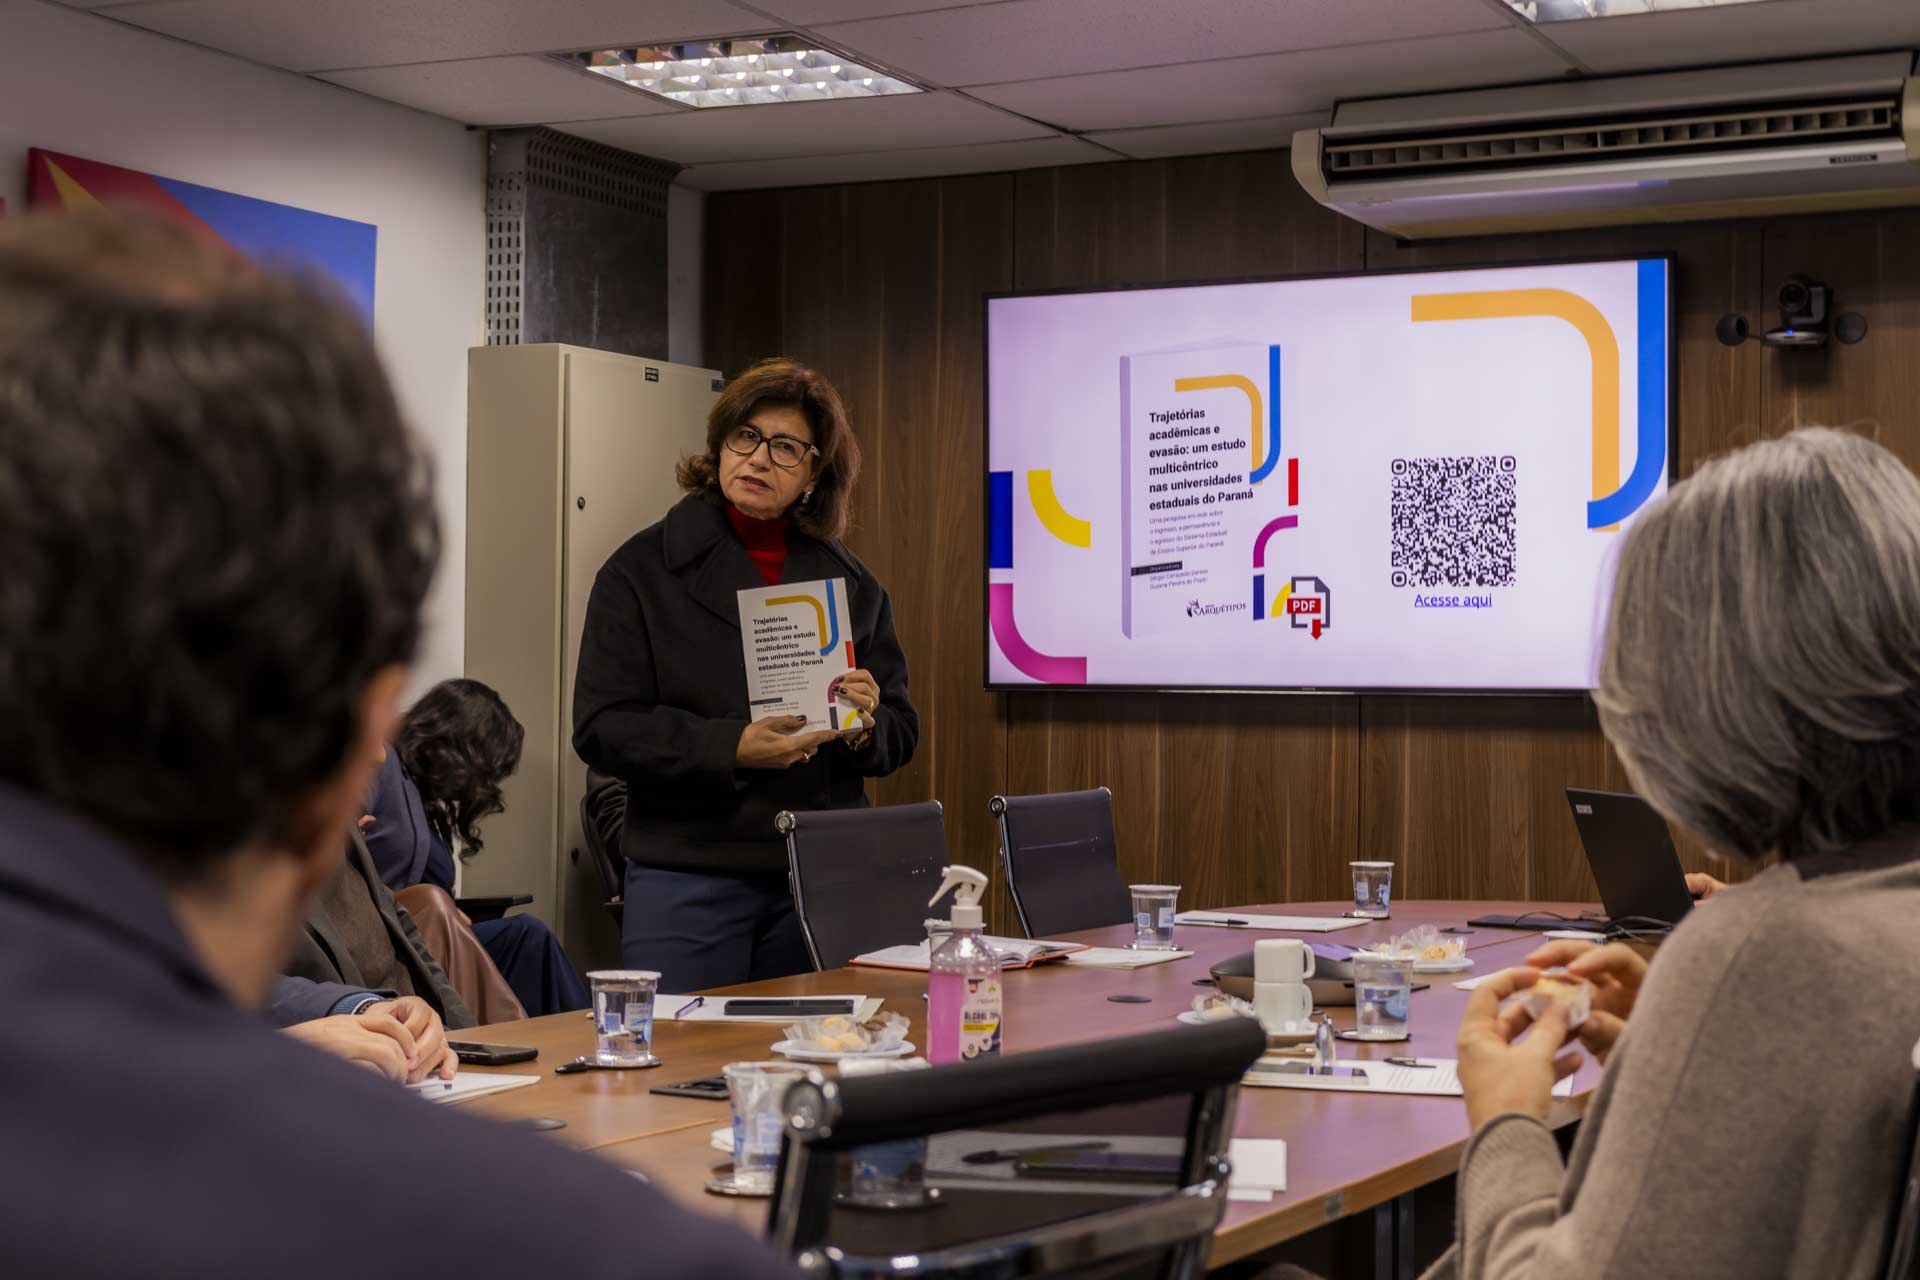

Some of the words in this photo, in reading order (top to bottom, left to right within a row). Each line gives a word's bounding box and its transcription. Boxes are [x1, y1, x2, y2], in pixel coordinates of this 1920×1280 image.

[1149, 408, 1205, 424] Trajetórias
[1149, 425, 1211, 440] acadêmicas
[1149, 444, 1189, 458] evasão:
[1192, 444, 1209, 454] um
[1211, 438, 1246, 452] estudo
[1149, 459, 1218, 475] multicêntrico
[1149, 483, 1168, 493] nas
[1171, 473, 1243, 490] universidades
[1149, 495, 1200, 510] estaduais
[1203, 493, 1215, 504] do
[1218, 488, 1253, 502] Paraná
[1292, 600, 1316, 611] PDF
[1415, 593, 1460, 608] Acesse
[1463, 593, 1492, 609] aqui
[753, 616, 788, 625] Trajetórias
[754, 625, 792, 634] acadêmicas
[755, 635, 780, 644] evasão:
[793, 631, 815, 639] estudo
[756, 642, 799, 653] multicêntrico
[770, 650, 815, 661] universidades
[758, 662, 789, 671] estaduais
[801, 658, 824, 666] Paraná
